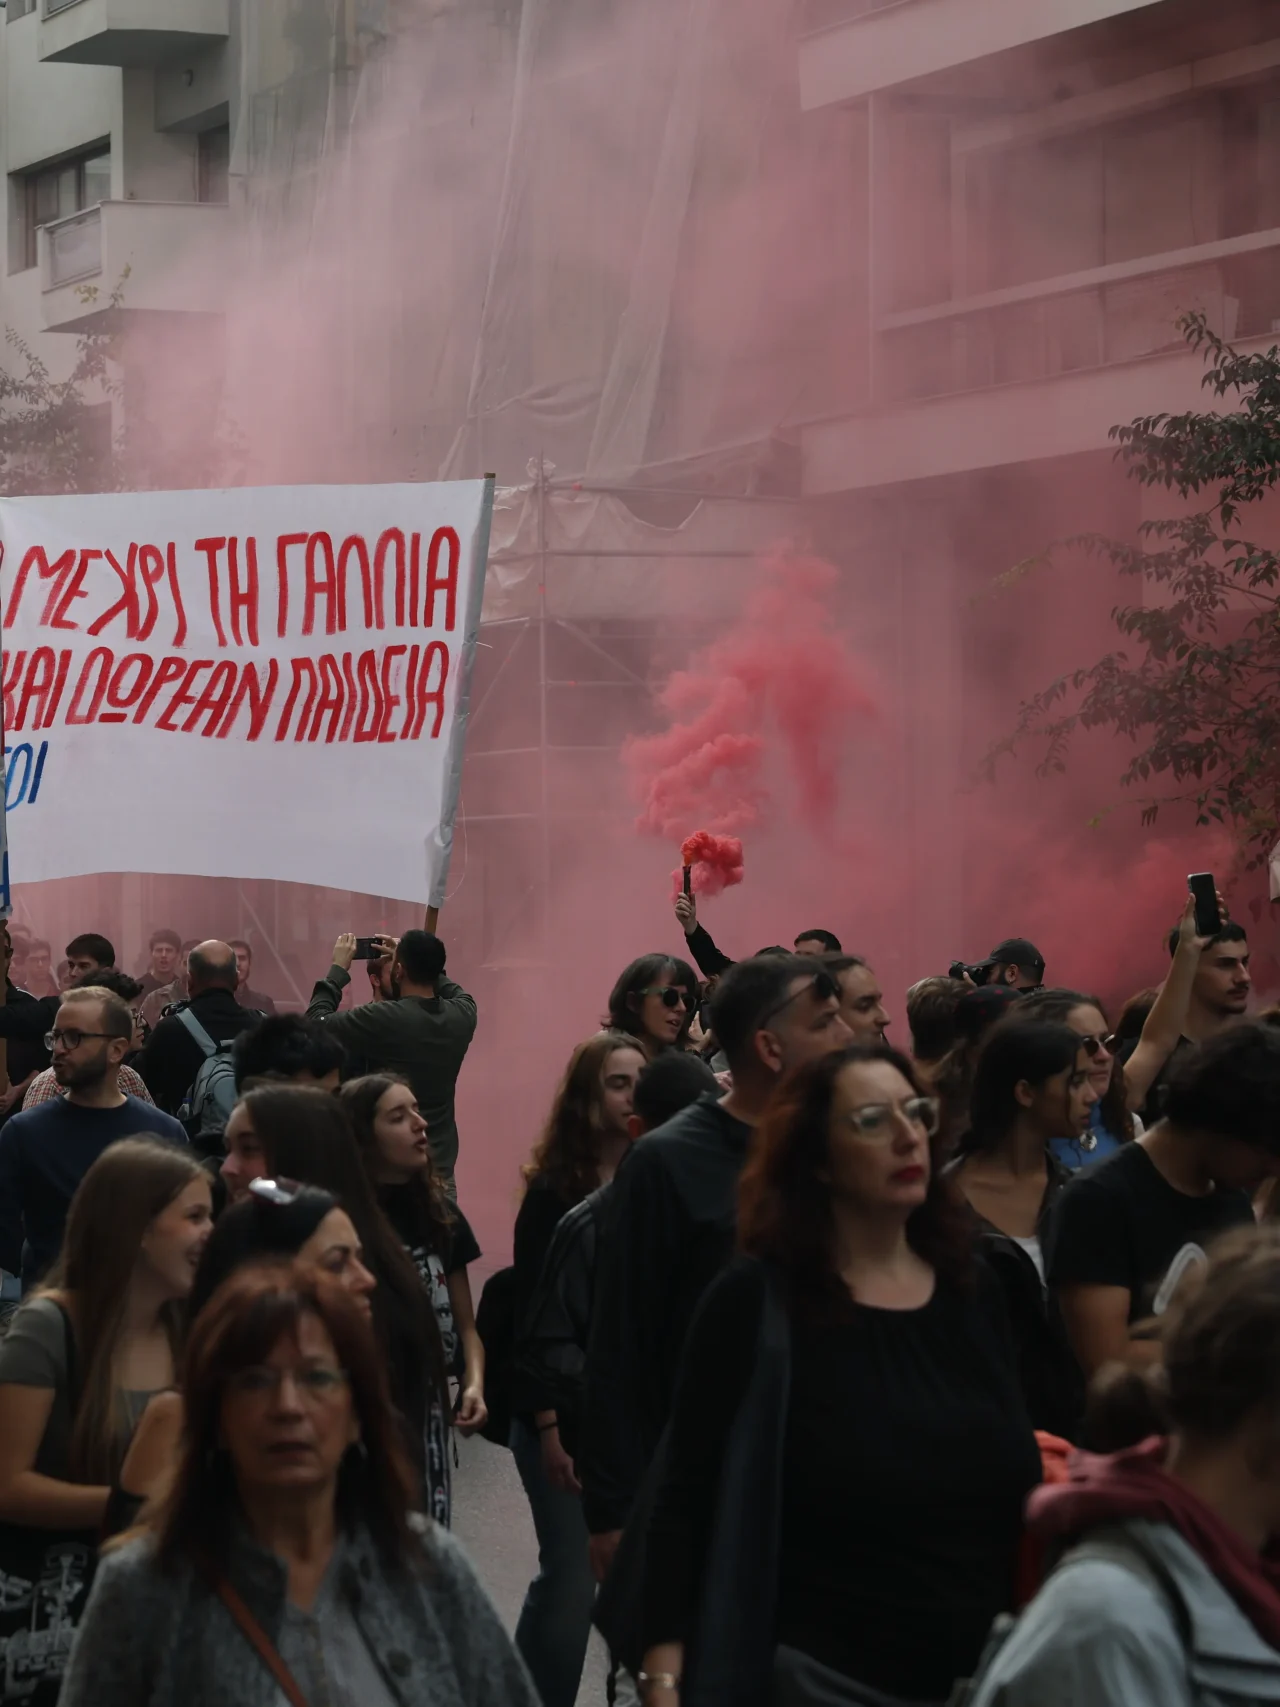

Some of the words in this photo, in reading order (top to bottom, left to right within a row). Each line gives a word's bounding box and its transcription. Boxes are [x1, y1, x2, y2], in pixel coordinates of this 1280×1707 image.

[4, 541, 189, 647] ΜΕΧΡΙ
[195, 536, 260, 647] ΤΗ
[277, 526, 462, 639] ΓΑΛΛΙΑ
[65, 646, 278, 743] ΔΩΡΕΑΝ
[275, 640, 451, 744] ΠΑΙΔΕΙΑ
